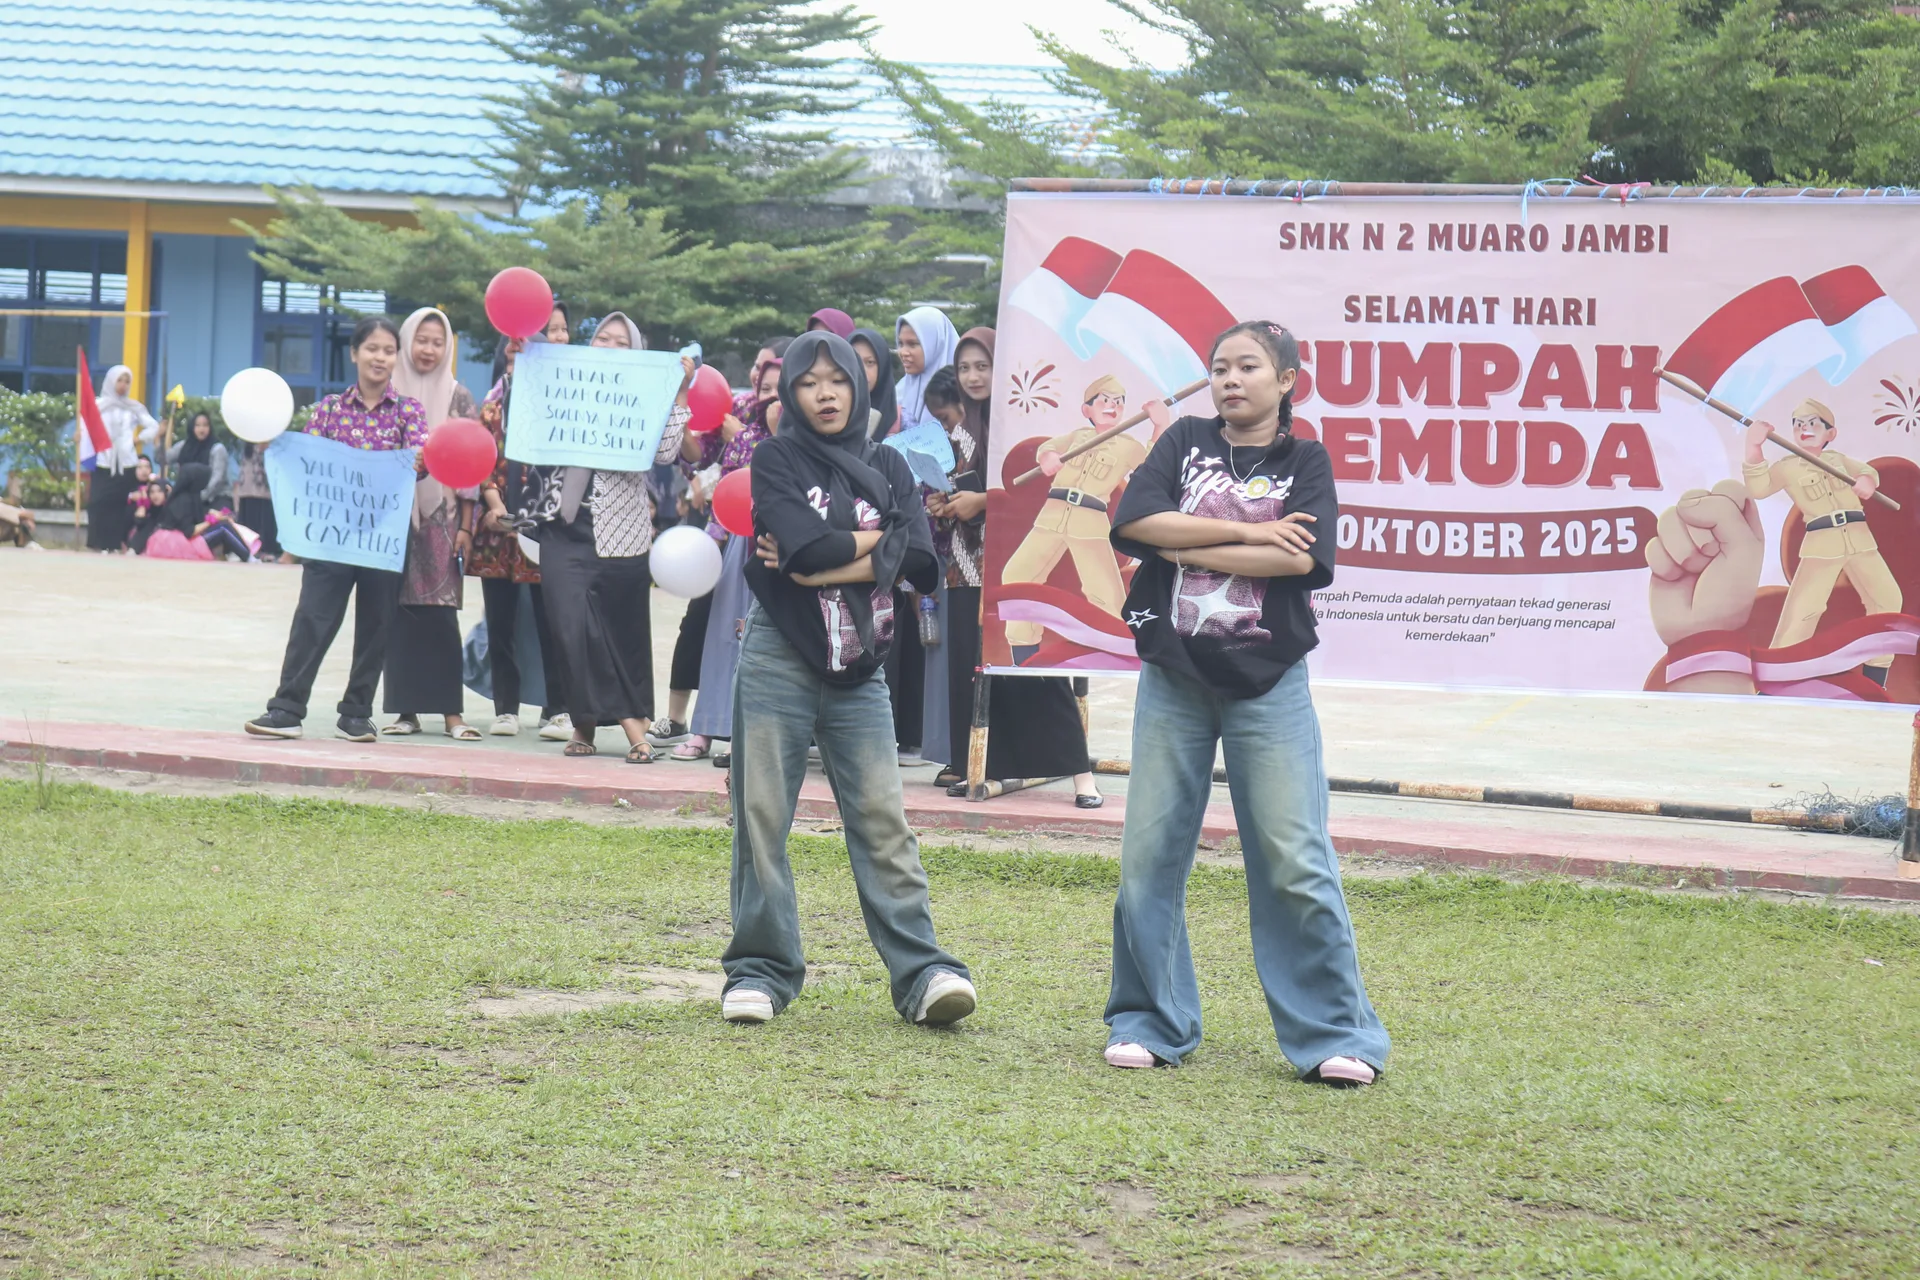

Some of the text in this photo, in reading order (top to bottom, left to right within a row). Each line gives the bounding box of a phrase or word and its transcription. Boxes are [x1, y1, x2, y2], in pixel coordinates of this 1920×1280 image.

[1279, 222, 1669, 253] SMK N 2 MUARO JAMBI
[1344, 295, 1598, 326] SELAMAT HARI
[1292, 416, 1664, 491] EMUDA
[1336, 514, 1638, 558] OKTOBER 2025
[1312, 591, 1612, 612] mpah Pemuda adalah pernyataan tekad generasi
[1326, 608, 1384, 622] Indonesia
[1386, 611, 1421, 622] untuk
[1423, 611, 1470, 625] bersatu
[1472, 614, 1495, 626] dan
[1497, 614, 1552, 630] berjuang
[1554, 618, 1616, 631] mencapai
